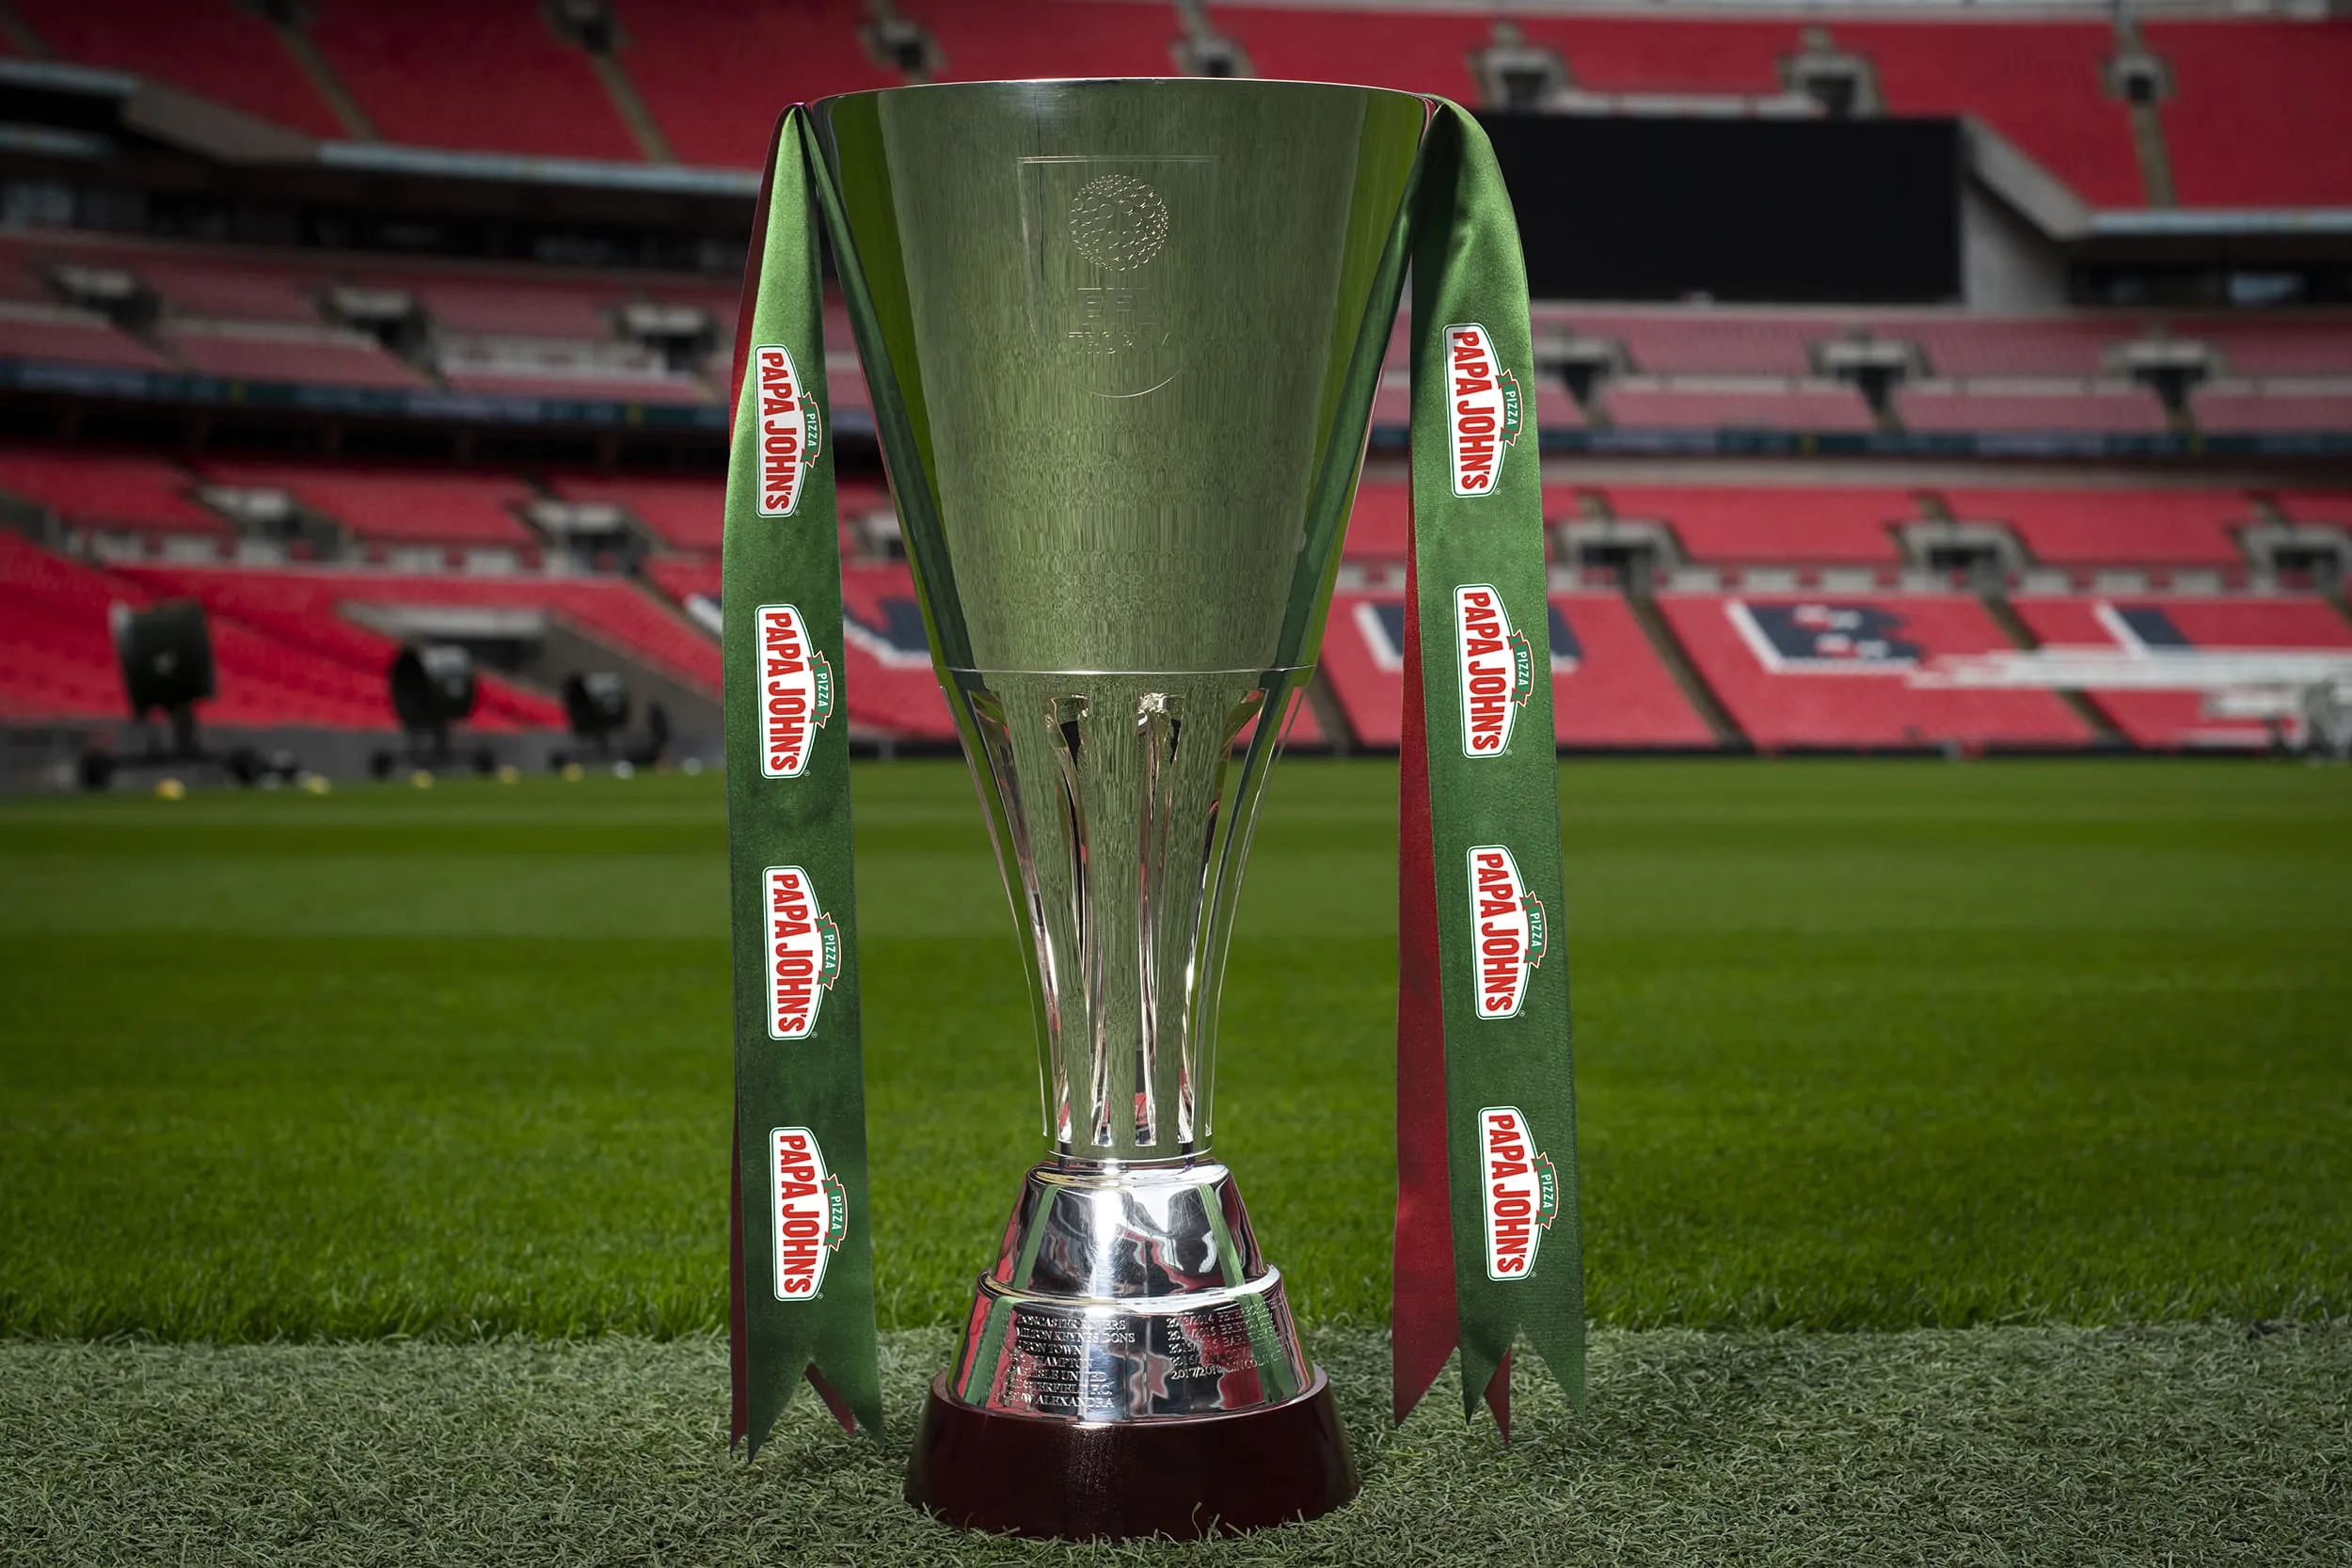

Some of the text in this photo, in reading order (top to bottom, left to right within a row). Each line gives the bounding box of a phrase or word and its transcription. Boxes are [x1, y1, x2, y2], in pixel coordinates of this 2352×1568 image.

[1068, 331, 1172, 355] TROPY
[1454, 331, 1495, 489] PAPA JOHN'S
[1505, 391, 1518, 425] PIZZA
[762, 353, 797, 509] PAPA JOHN'S
[806, 414, 818, 447] PIZZA
[1464, 593, 1506, 750] PAPA JOHN'S
[1517, 651, 1529, 686] PIZZA
[766, 613, 806, 770] PAPA JOHN'S
[817, 673, 829, 706] PIZZA
[1477, 854, 1519, 1011] PAPA JOHN'S
[1530, 912, 1542, 947] PIZZA
[773, 875, 813, 1032] PAPA JOHN'S
[824, 934, 836, 969] PIZZA
[1488, 1115, 1531, 1273] PAPA JOHN'S
[1541, 1174, 1553, 1209] PIZZA
[781, 1135, 819, 1292] PAPA JOHN'S
[831, 1196, 842, 1230] PIZZA
[1082, 1319, 1126, 1330] RERS
[1102, 1332, 1136, 1343] DONS
[1036, 1394, 1115, 1408] ALEXANDRA
